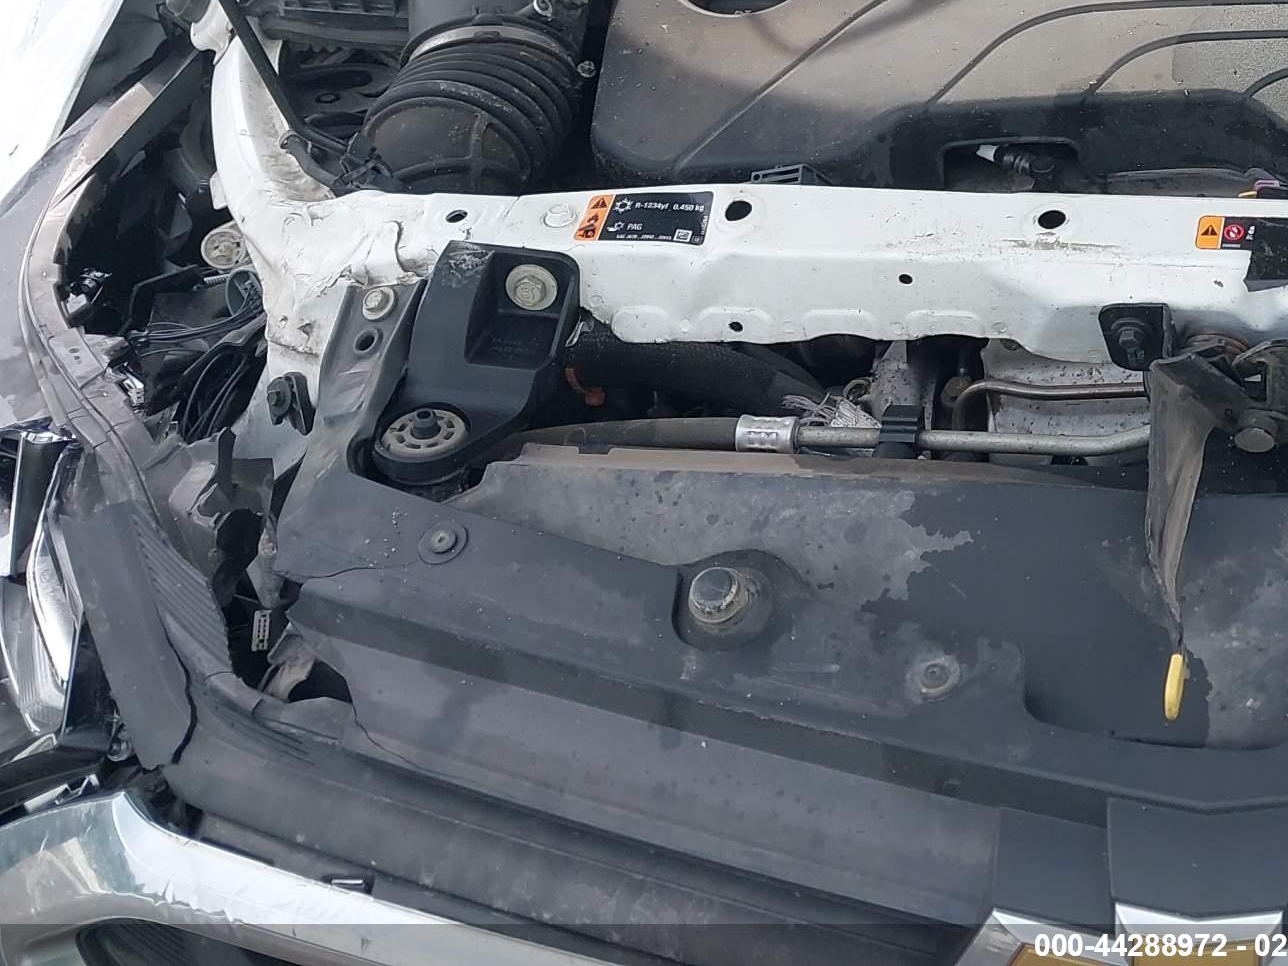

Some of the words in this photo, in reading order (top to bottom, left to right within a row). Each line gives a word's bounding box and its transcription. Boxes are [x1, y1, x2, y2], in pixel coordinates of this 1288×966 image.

[634, 201, 669, 211] R-1234yf
[672, 203, 694, 212] 0.450
[695, 204, 705, 213] kg
[626, 223, 643, 231] PAG
